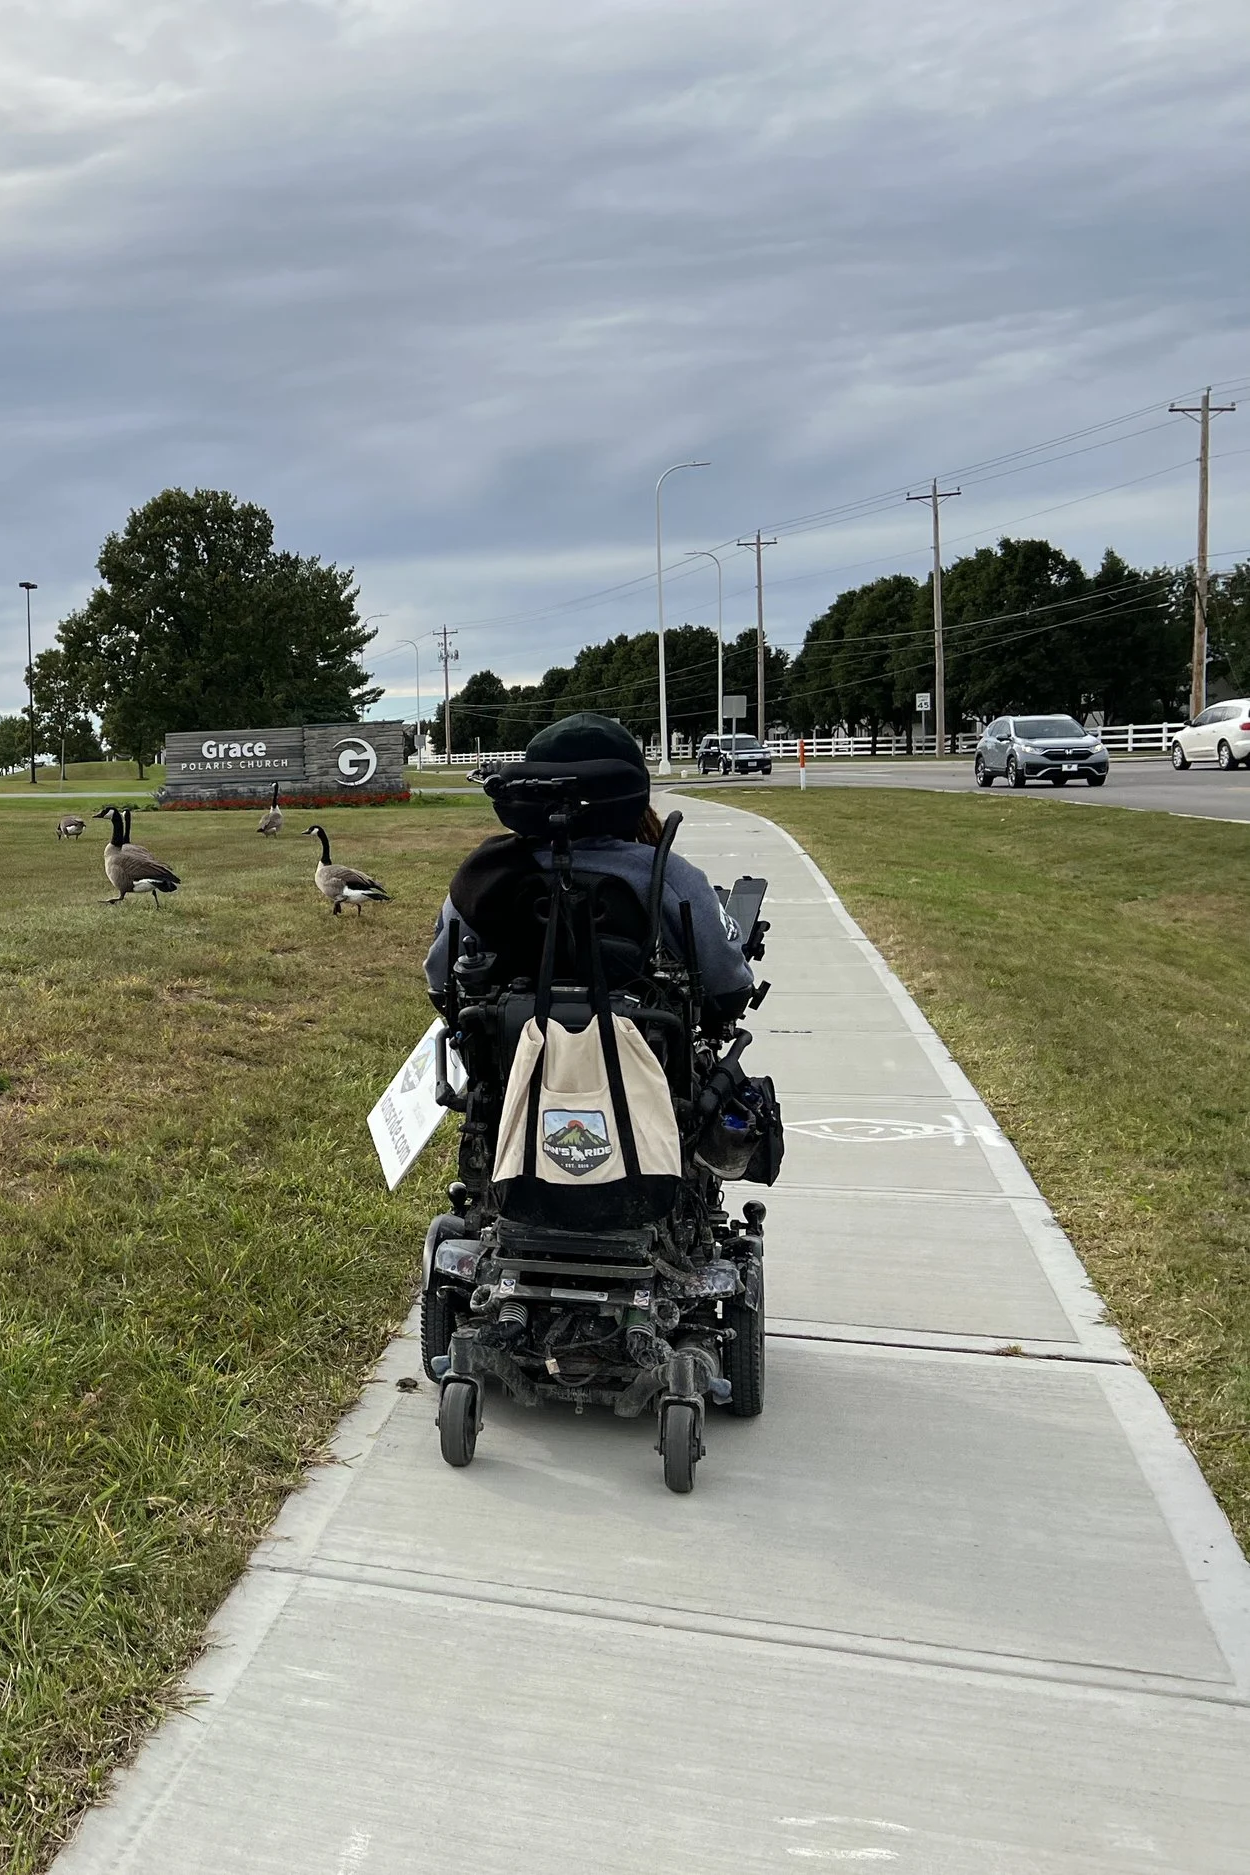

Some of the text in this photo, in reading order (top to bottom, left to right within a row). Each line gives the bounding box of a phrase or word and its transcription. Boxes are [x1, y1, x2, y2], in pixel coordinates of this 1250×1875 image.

[917, 701, 929, 709] 45
[201, 740, 267, 759] Grace
[181, 759, 288, 771] POLARIS CHURCH
[584, 1145, 612, 1157] RIDE
